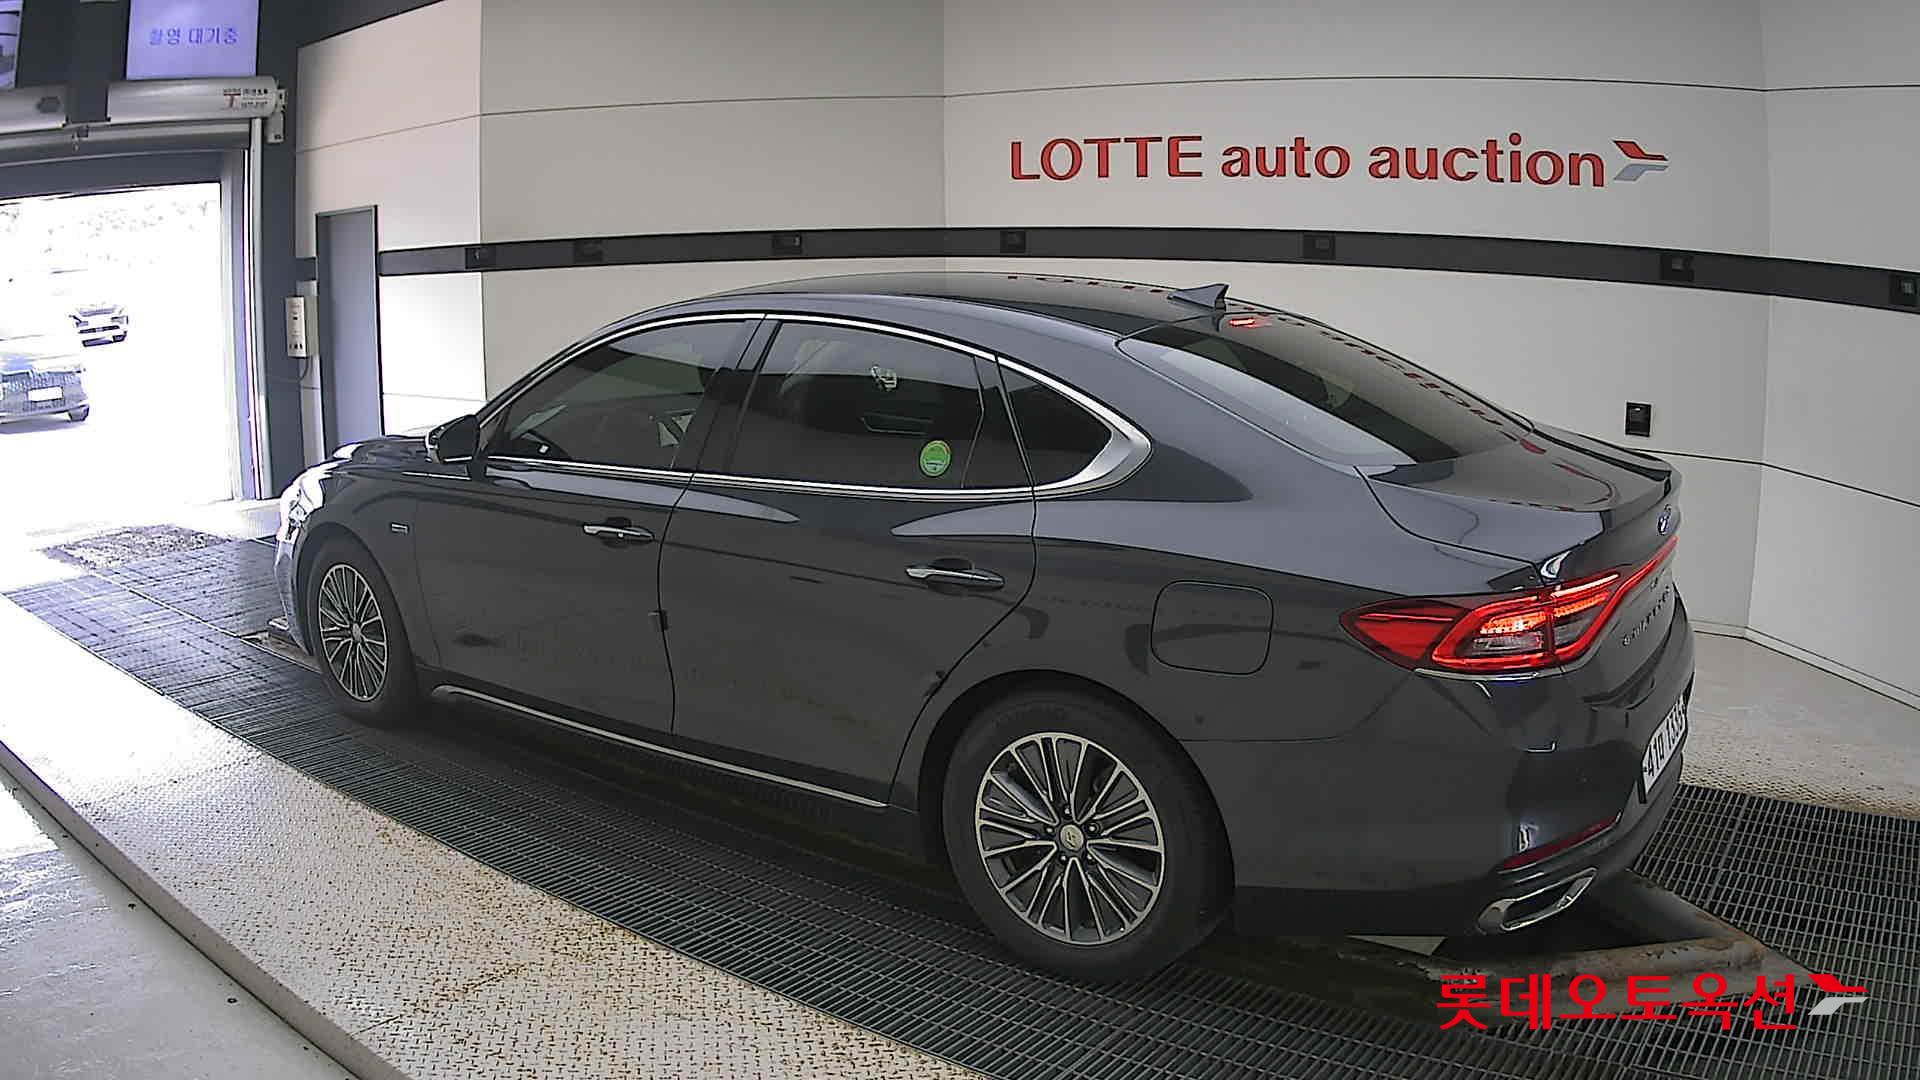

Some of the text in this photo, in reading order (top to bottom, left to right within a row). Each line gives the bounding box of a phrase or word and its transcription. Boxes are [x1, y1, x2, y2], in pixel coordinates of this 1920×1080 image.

[188, 26, 238, 45] 대기중
[1010, 133, 1606, 187] LOTTE auto auction
